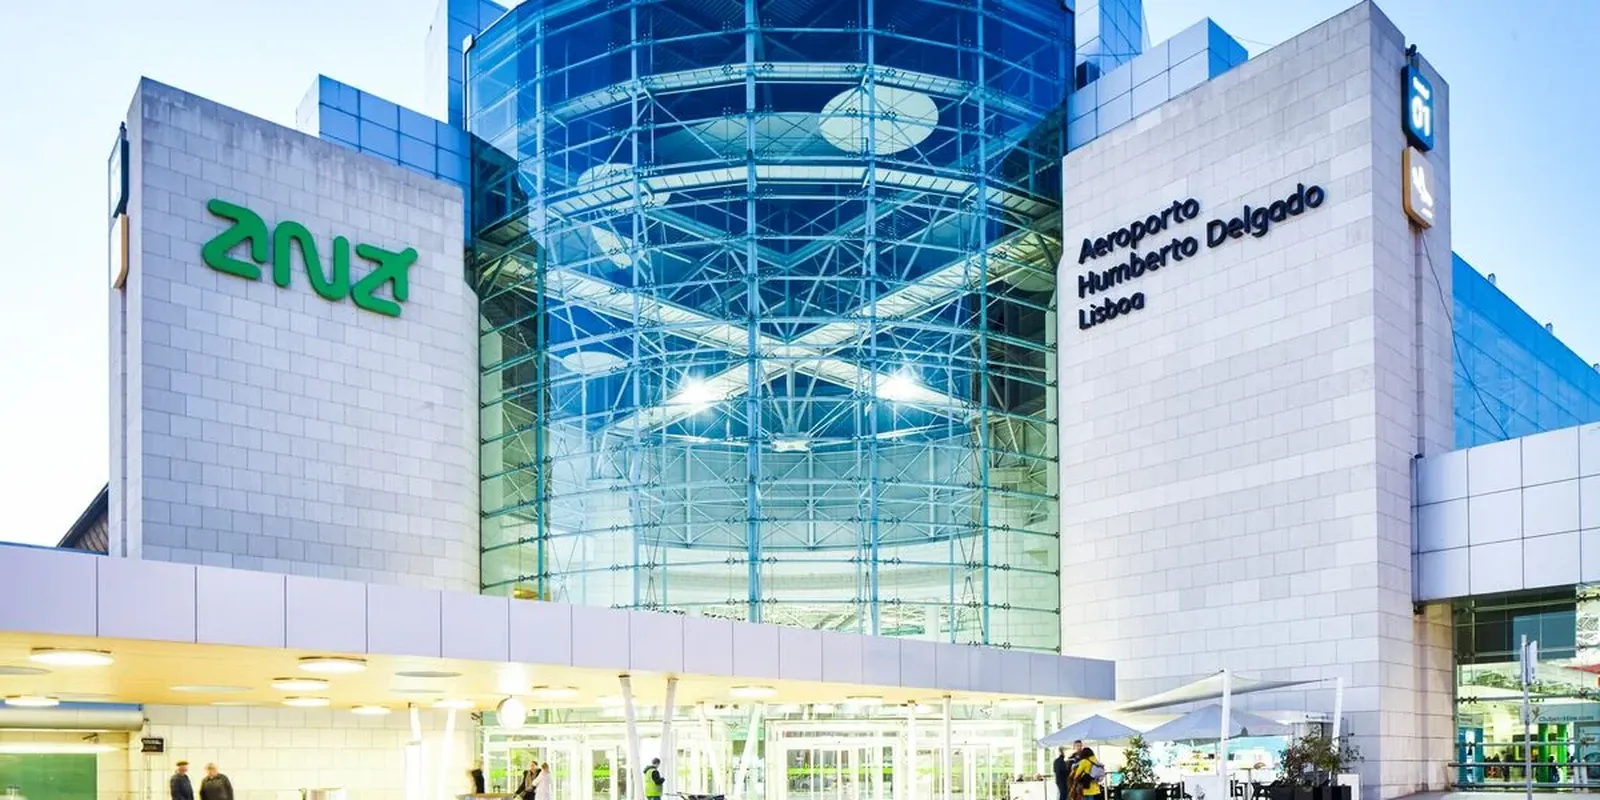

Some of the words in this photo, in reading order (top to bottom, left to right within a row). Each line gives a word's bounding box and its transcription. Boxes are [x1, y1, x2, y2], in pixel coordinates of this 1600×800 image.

[1078, 198, 1200, 264] Aeroporto
[1078, 236, 1199, 298] Humberto
[1206, 183, 1325, 249] Delgado
[1078, 292, 1145, 330] Lisboa
